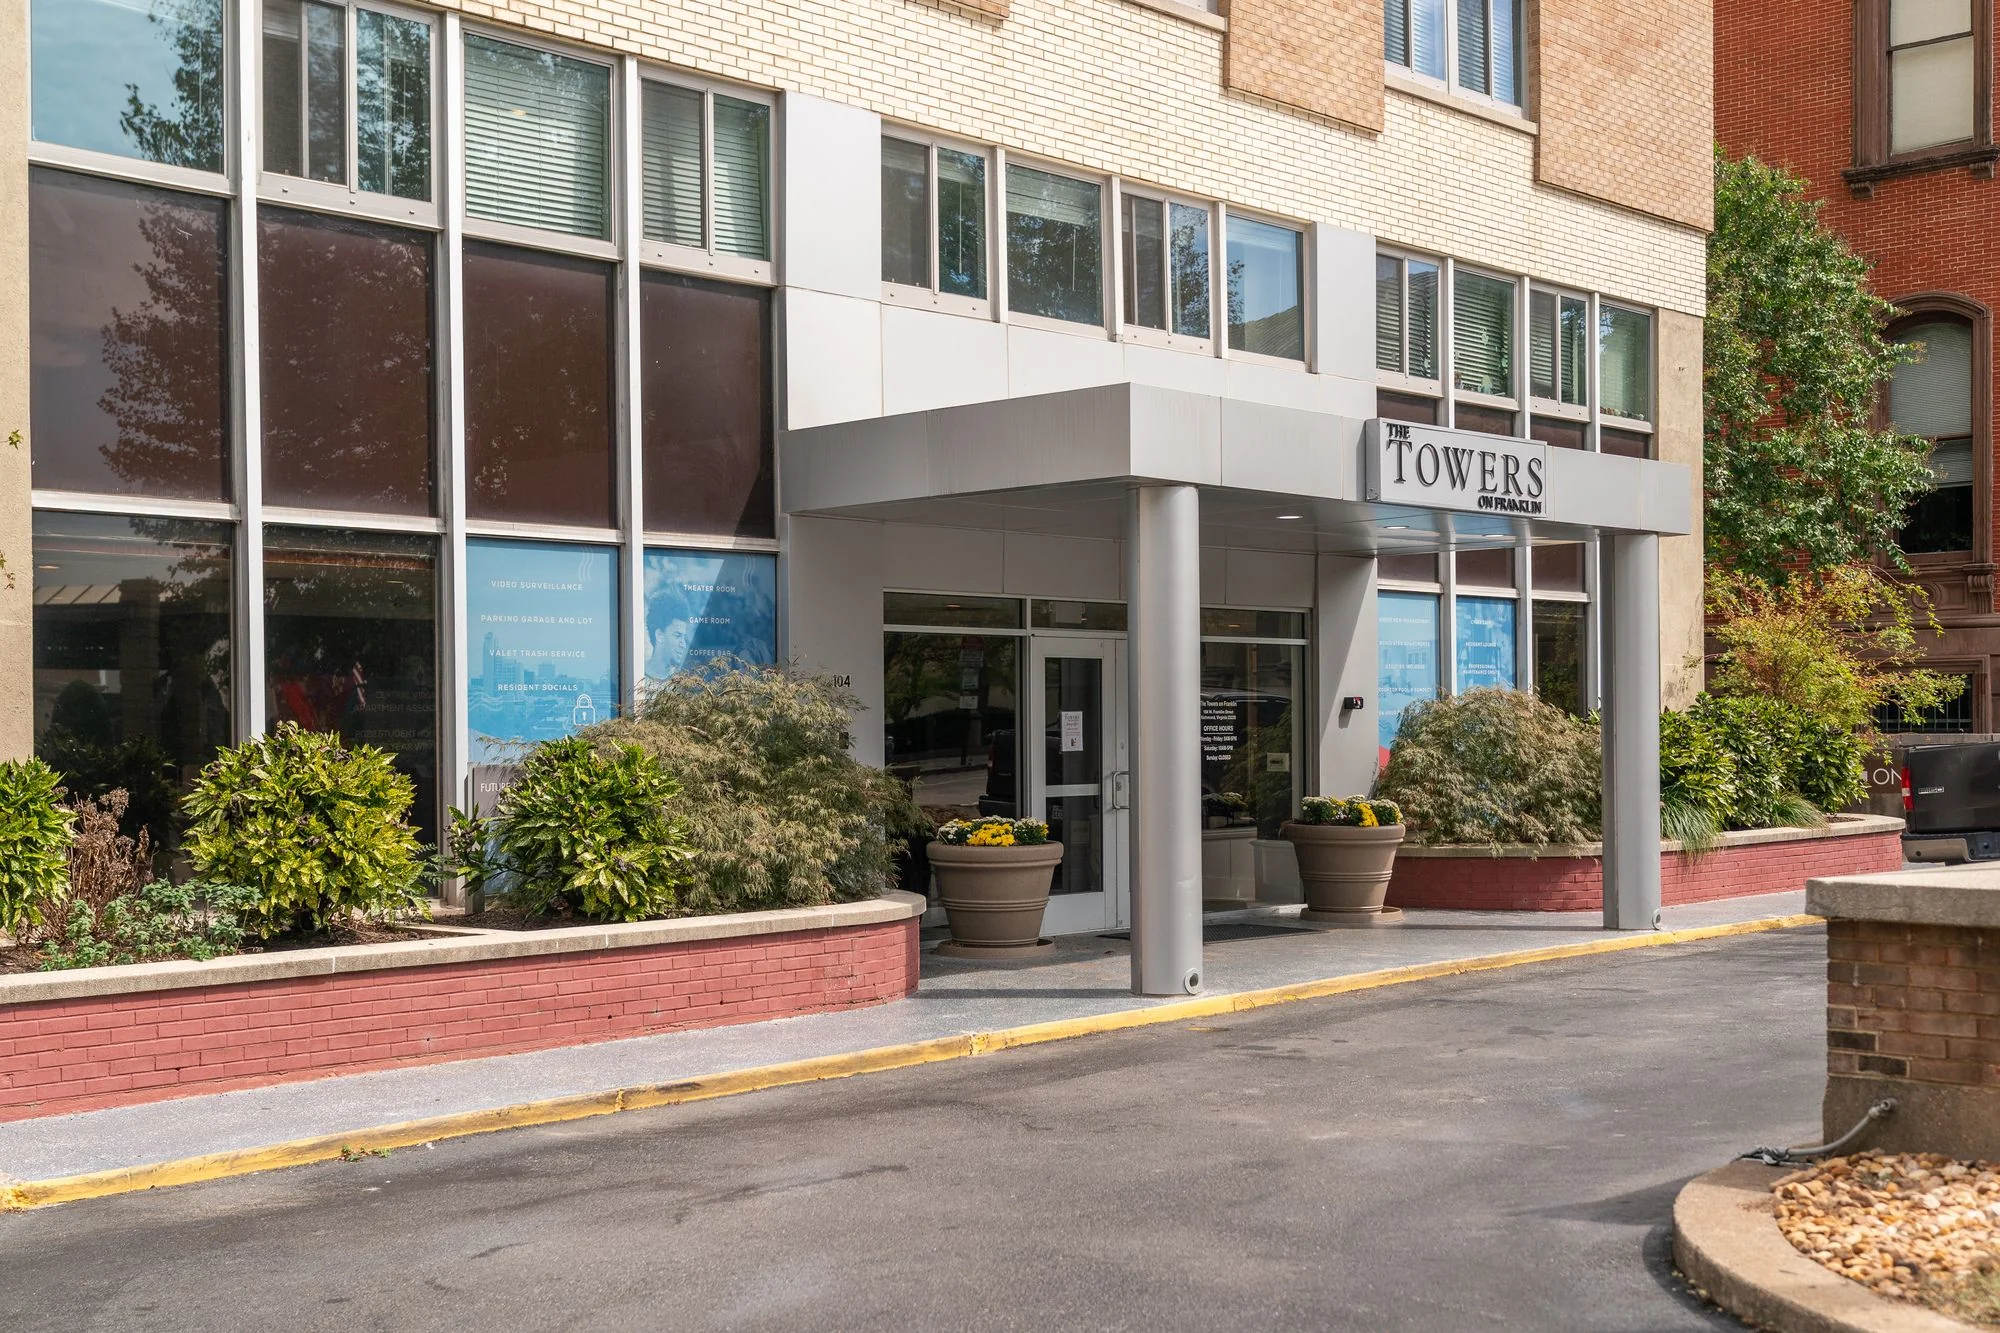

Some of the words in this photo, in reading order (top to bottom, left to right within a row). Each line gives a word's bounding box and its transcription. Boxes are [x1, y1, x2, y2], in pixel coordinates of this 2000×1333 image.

[1386, 423, 1411, 439] THE
[1386, 438, 1543, 499] TOWERS
[1478, 495, 1494, 509] ON
[1494, 496, 1542, 515] FRANKLIN
[490, 580, 518, 588] VIDEO
[520, 581, 584, 591] SURVEILLANCE
[683, 584, 714, 592] THEATER
[480, 614, 519, 622] PARKING
[521, 615, 556, 624] GARAGE
[558, 616, 575, 624] AND
[577, 617, 593, 625] LOT
[489, 649, 518, 657] VALET
[520, 650, 548, 658] TRASH
[550, 650, 586, 658] SERVICE
[832, 674, 850, 688] 104
[498, 684, 540, 692] RESIDENT
[542, 684, 578, 692] SOCIALS
